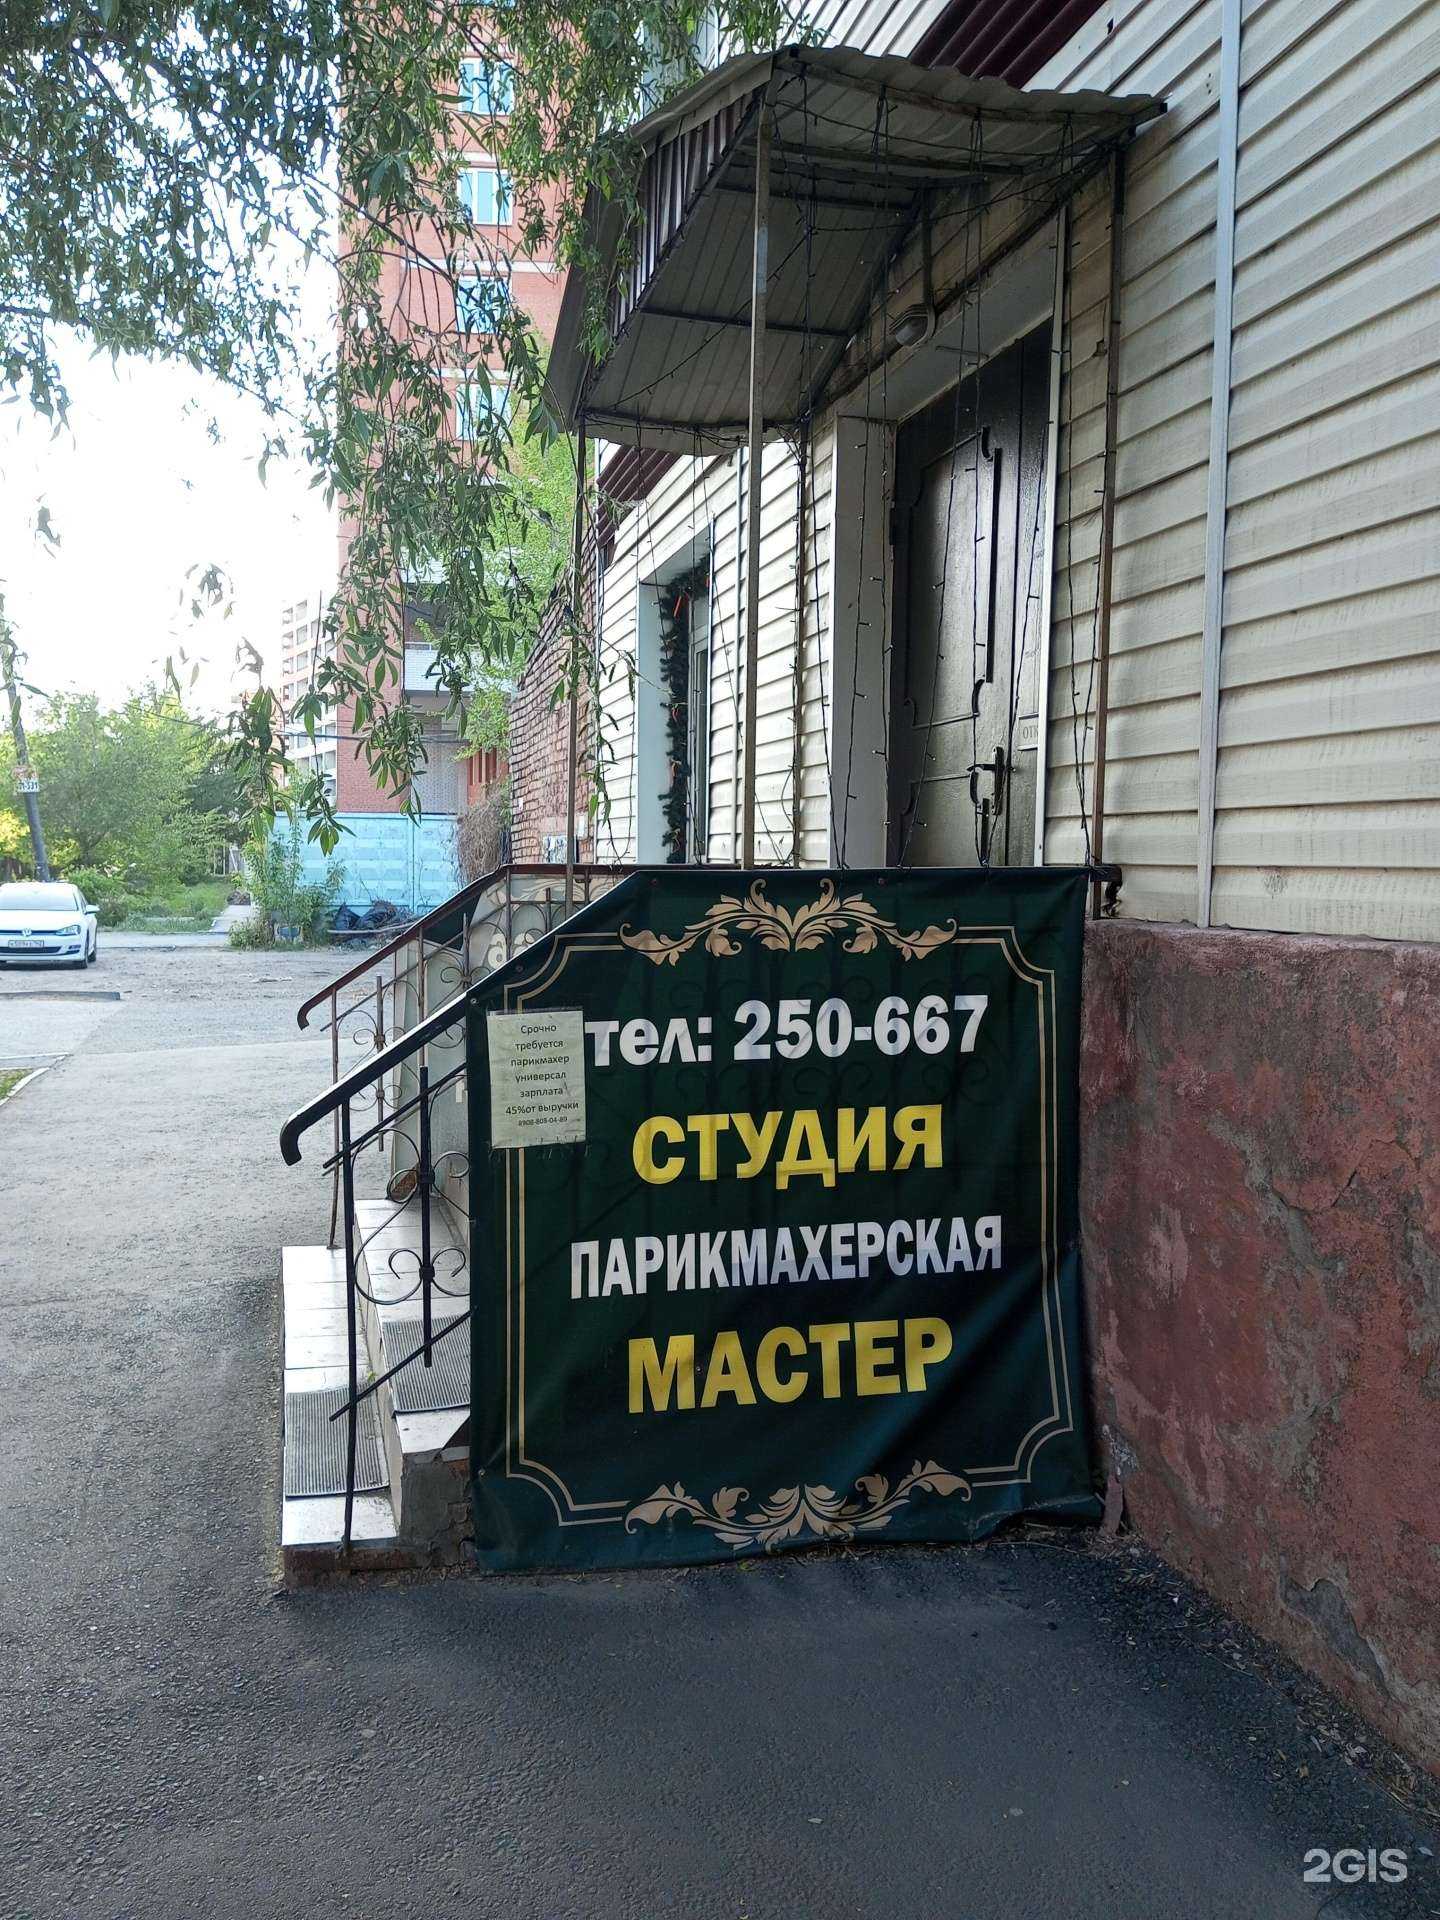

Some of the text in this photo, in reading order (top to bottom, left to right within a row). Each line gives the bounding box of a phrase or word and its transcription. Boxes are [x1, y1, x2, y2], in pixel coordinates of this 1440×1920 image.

[520, 1024, 557, 1035] Срочно
[585, 994, 989, 1067] тел: 250-667
[515, 1040, 564, 1052] требуется
[510, 1056, 570, 1067] парикмахер
[515, 1072, 566, 1083] универсал
[519, 1087, 564, 1099] зарплата
[505, 1103, 579, 1115] 45%от выручки
[632, 1104, 944, 1191] СТУДИЯ
[570, 1215, 1003, 1300] ПАРИКМАХЕРСКАЯ
[627, 1317, 954, 1414] МАСТЕР
